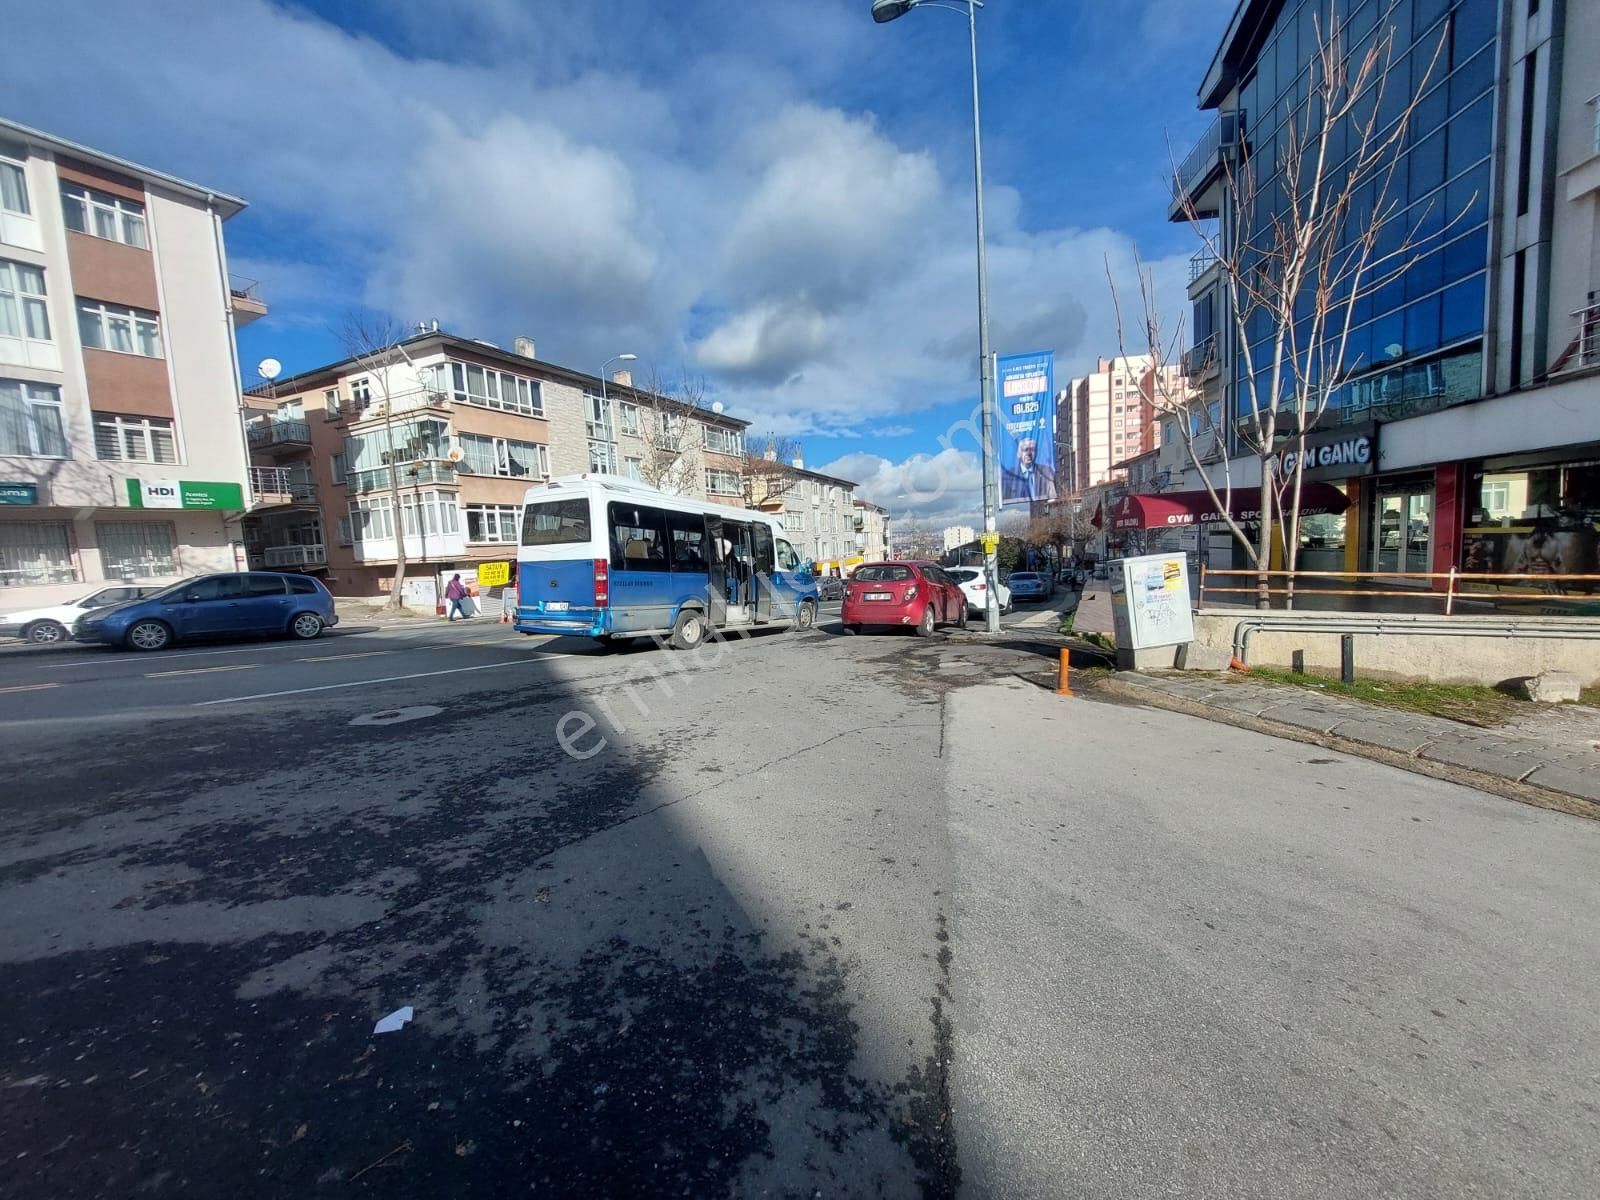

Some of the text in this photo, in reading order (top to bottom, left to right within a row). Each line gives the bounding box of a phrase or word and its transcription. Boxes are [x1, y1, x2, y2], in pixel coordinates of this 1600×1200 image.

[1284, 438, 1370, 474] GM GANG
[148, 487, 175, 496] HDI
[1167, 507, 1328, 523] GYM GAG SPO SAONU
